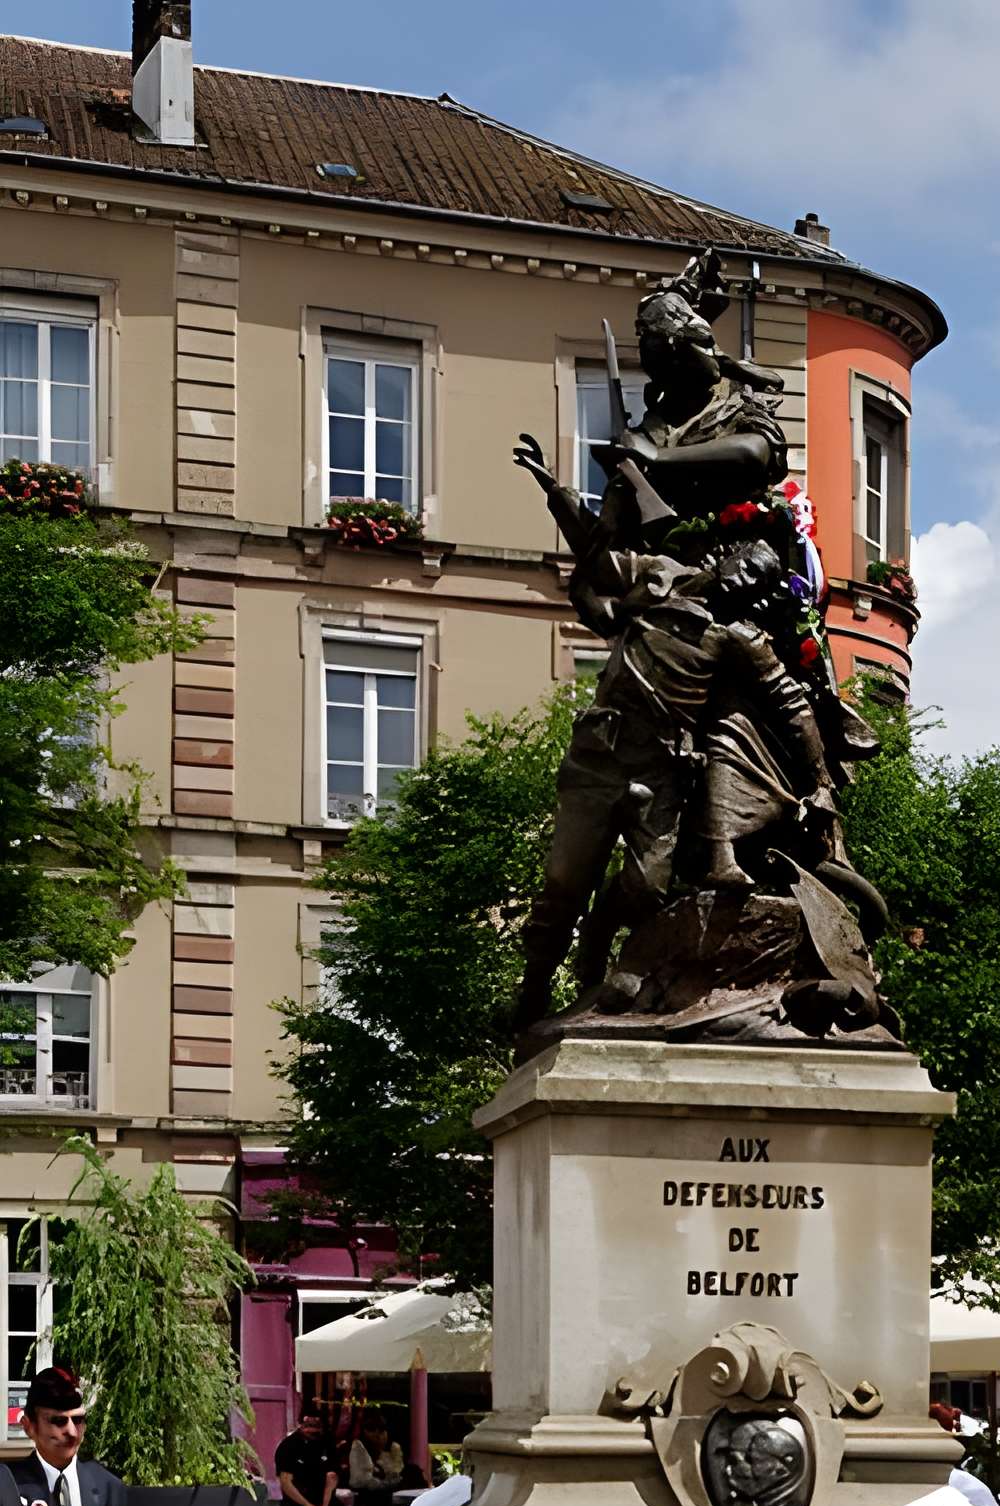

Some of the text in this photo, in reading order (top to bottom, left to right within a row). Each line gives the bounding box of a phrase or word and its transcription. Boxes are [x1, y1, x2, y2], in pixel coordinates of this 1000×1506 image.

[718, 1138, 770, 1162] AUX
[664, 1181, 825, 1209] DEFENSEURS
[728, 1228, 760, 1252] DE
[687, 1271, 799, 1296] BELFORT
